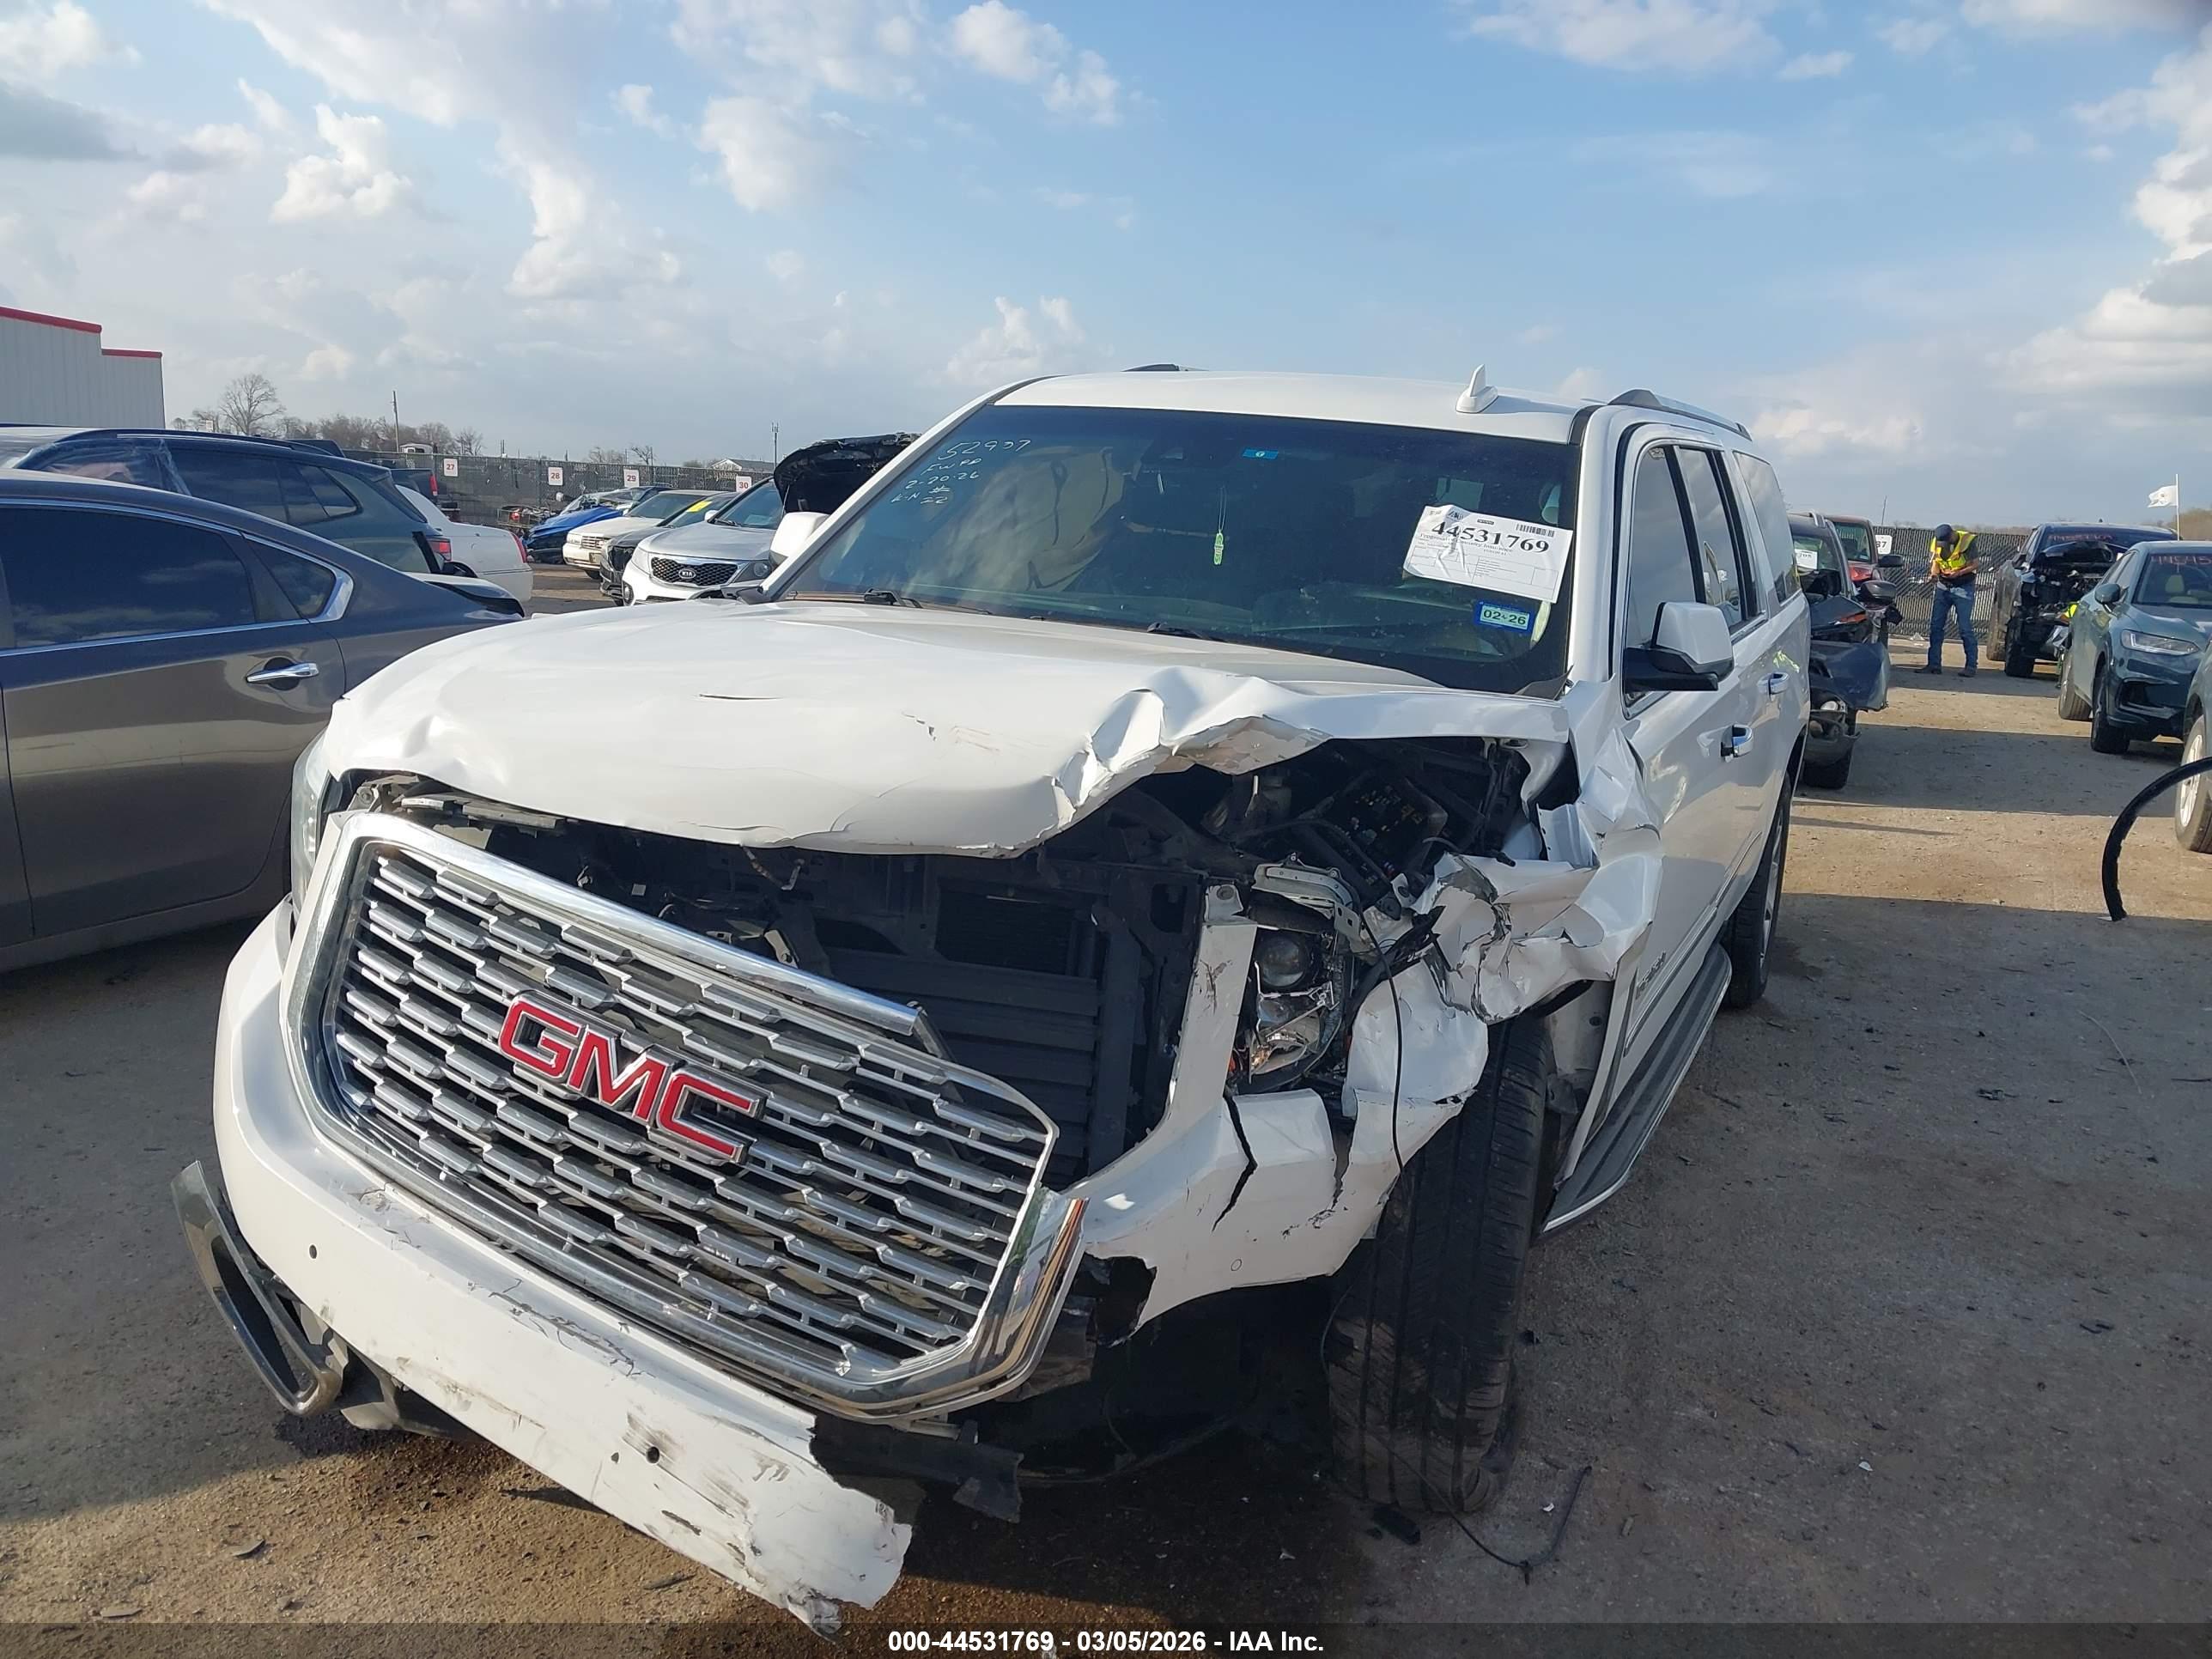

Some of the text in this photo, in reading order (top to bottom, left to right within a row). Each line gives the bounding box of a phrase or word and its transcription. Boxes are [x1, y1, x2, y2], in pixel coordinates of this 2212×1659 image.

[738, 481, 749, 489] 30
[1431, 521, 1549, 553] 44531769
[1483, 610, 1527, 625] 02 26
[498, 994, 763, 1163] GMC
